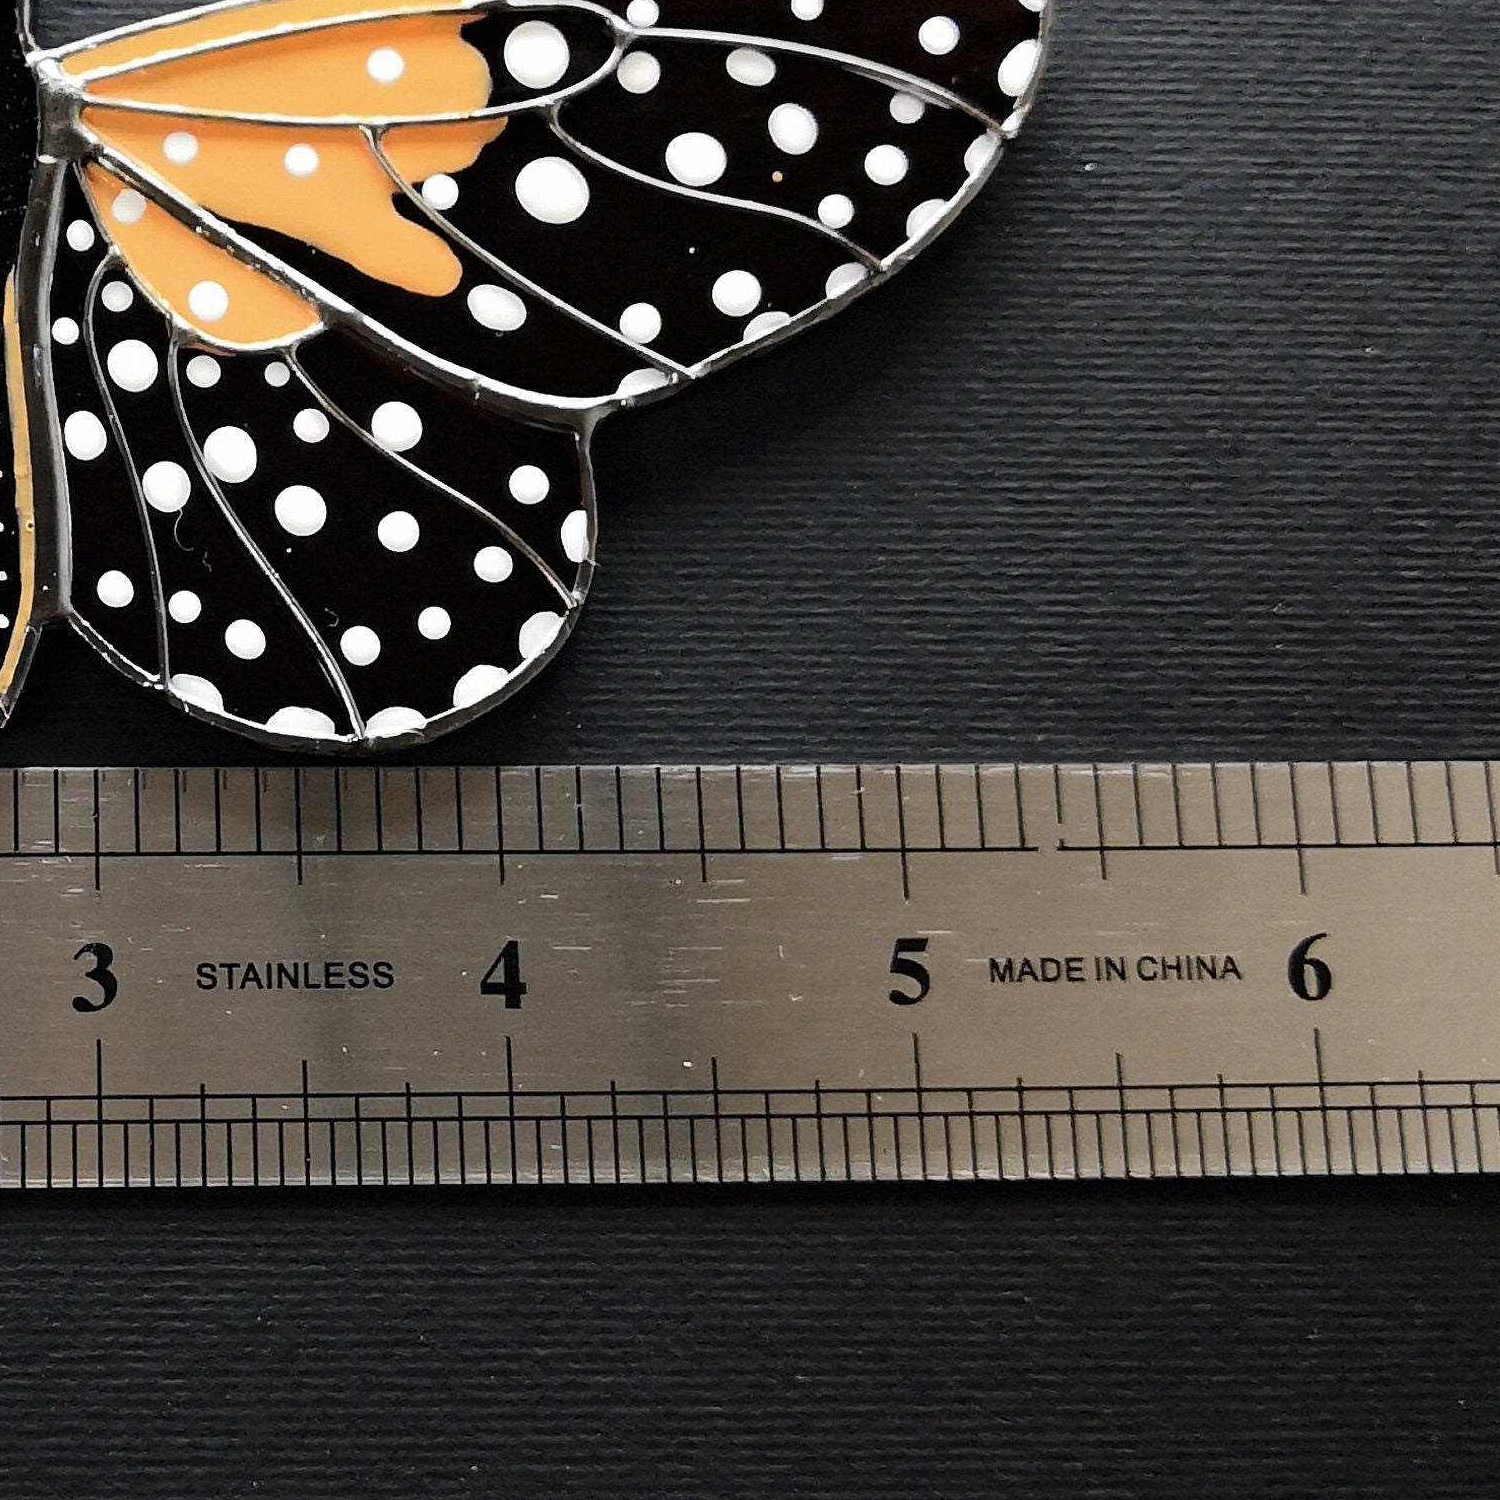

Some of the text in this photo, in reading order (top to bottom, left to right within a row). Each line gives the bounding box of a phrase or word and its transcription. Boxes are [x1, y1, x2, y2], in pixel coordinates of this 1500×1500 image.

[71, 941, 119, 1012] 3
[195, 961, 395, 991] STAINLESS
[480, 939, 528, 1009] 4
[888, 937, 931, 1006] 5
[988, 953, 1242, 984] MADE IN CHINA
[1287, 931, 1333, 1001] 6
